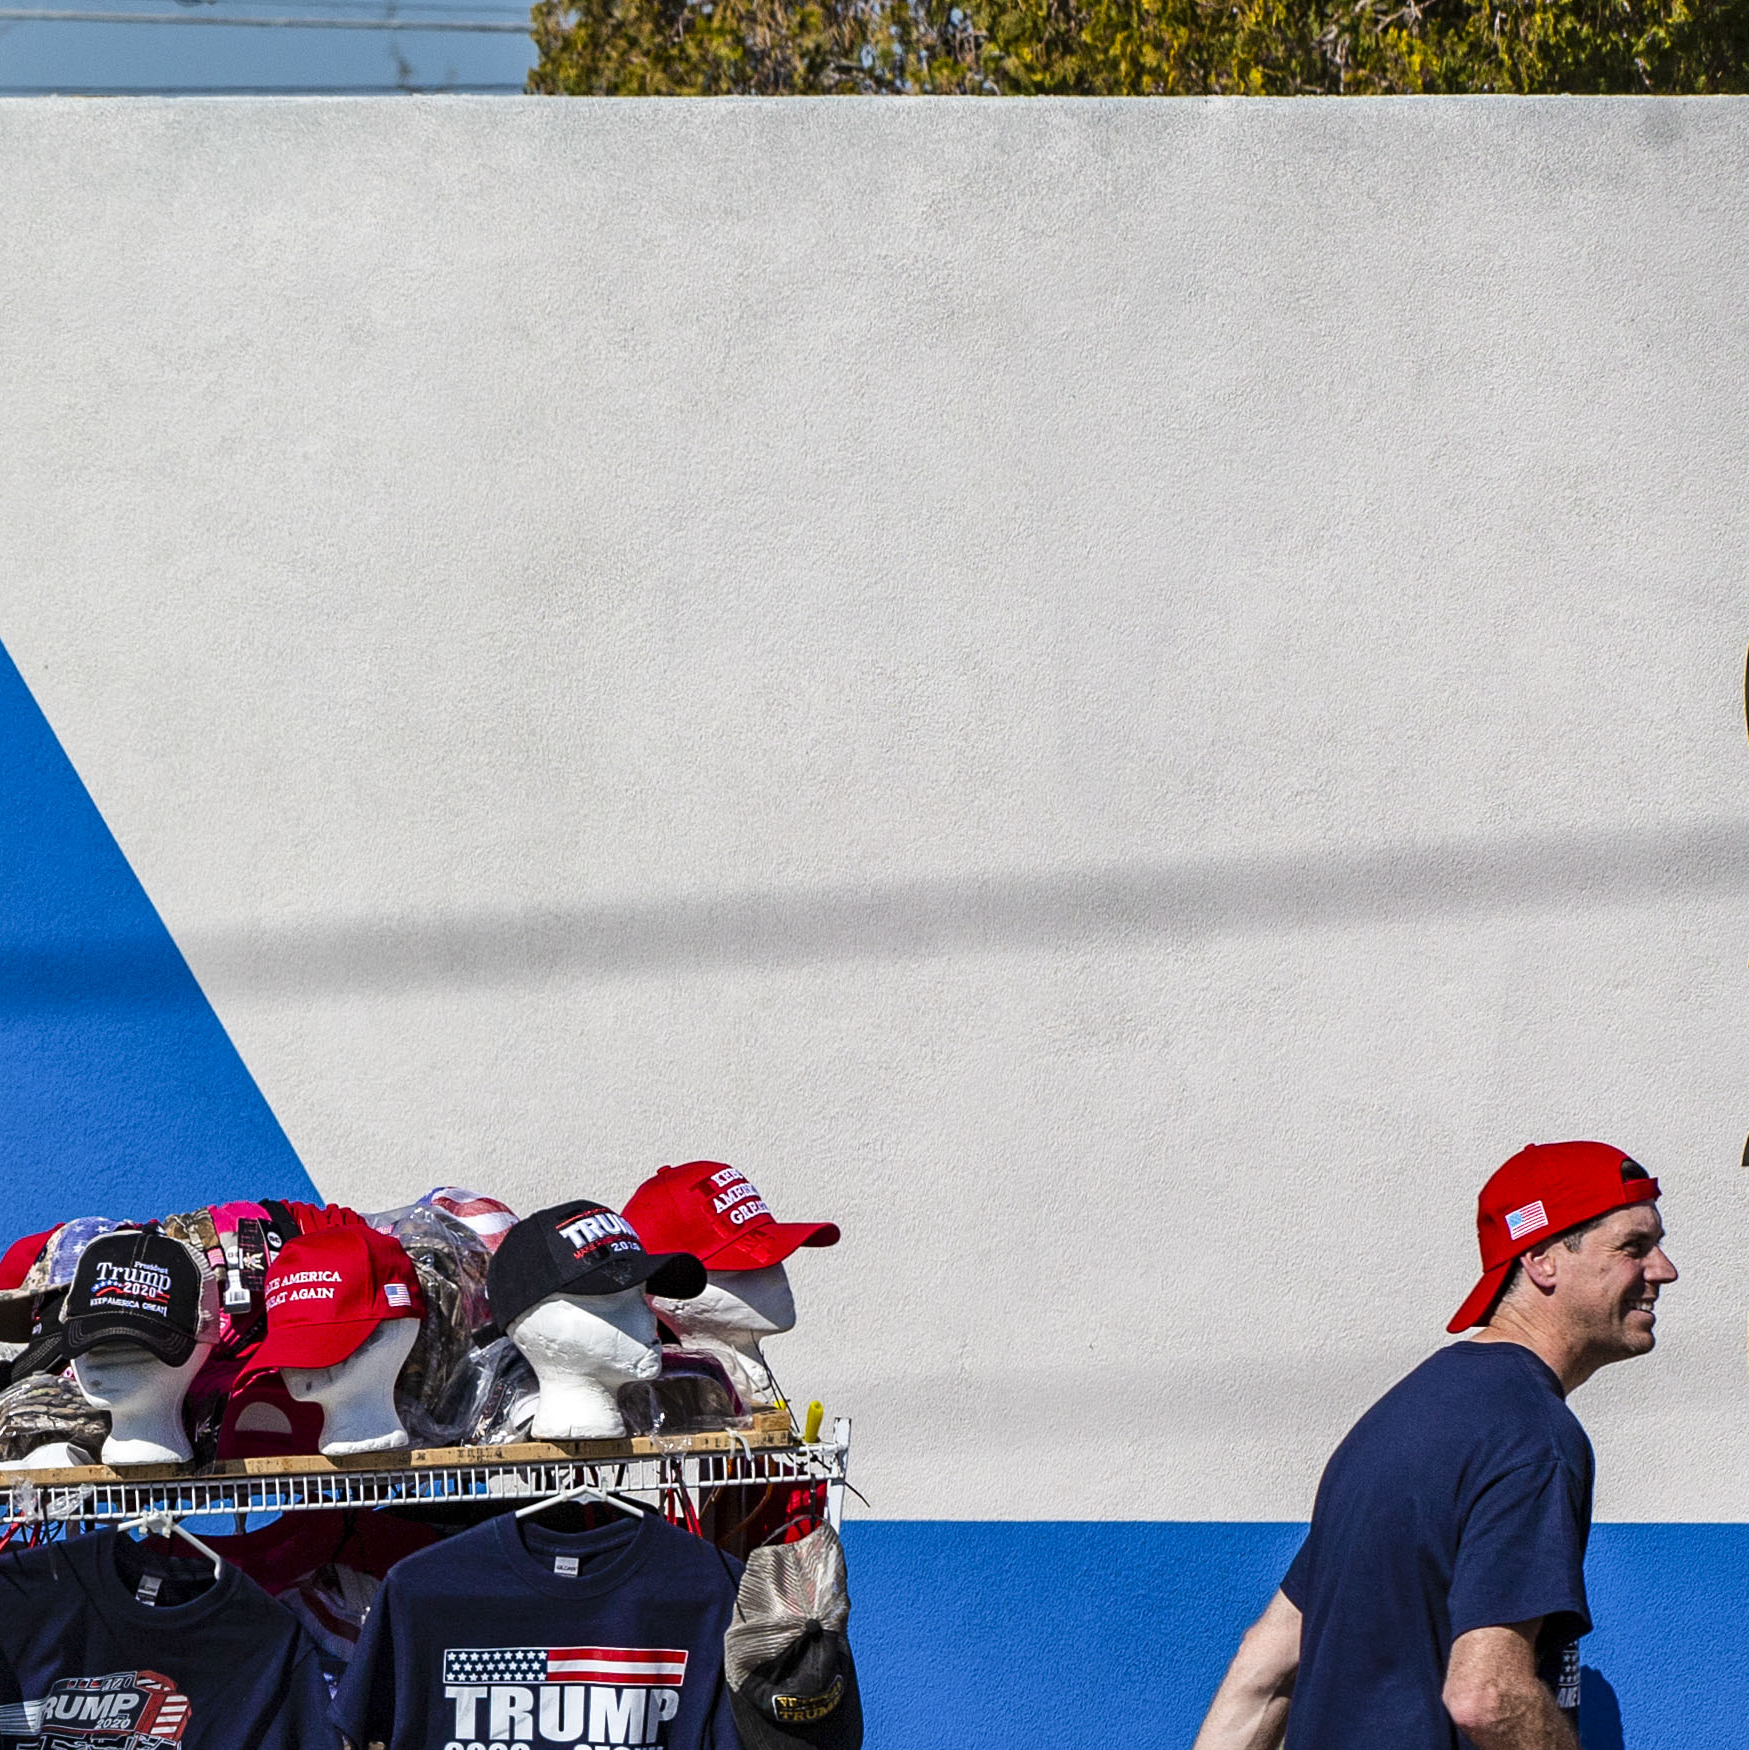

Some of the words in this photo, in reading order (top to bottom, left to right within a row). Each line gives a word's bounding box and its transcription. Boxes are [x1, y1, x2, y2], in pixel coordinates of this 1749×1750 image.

[96, 1262, 172, 1294] Trump
[281, 1271, 342, 1287] AMERICA
[123, 1282, 157, 1298] 2020
[289, 1288, 335, 1301] AGAIN
[107, 1297, 140, 1309] AMERICA
[39, 1693, 140, 1724] RUMP
[444, 1686, 679, 1744] TRUMP
[96, 1719, 132, 1730] 2020
